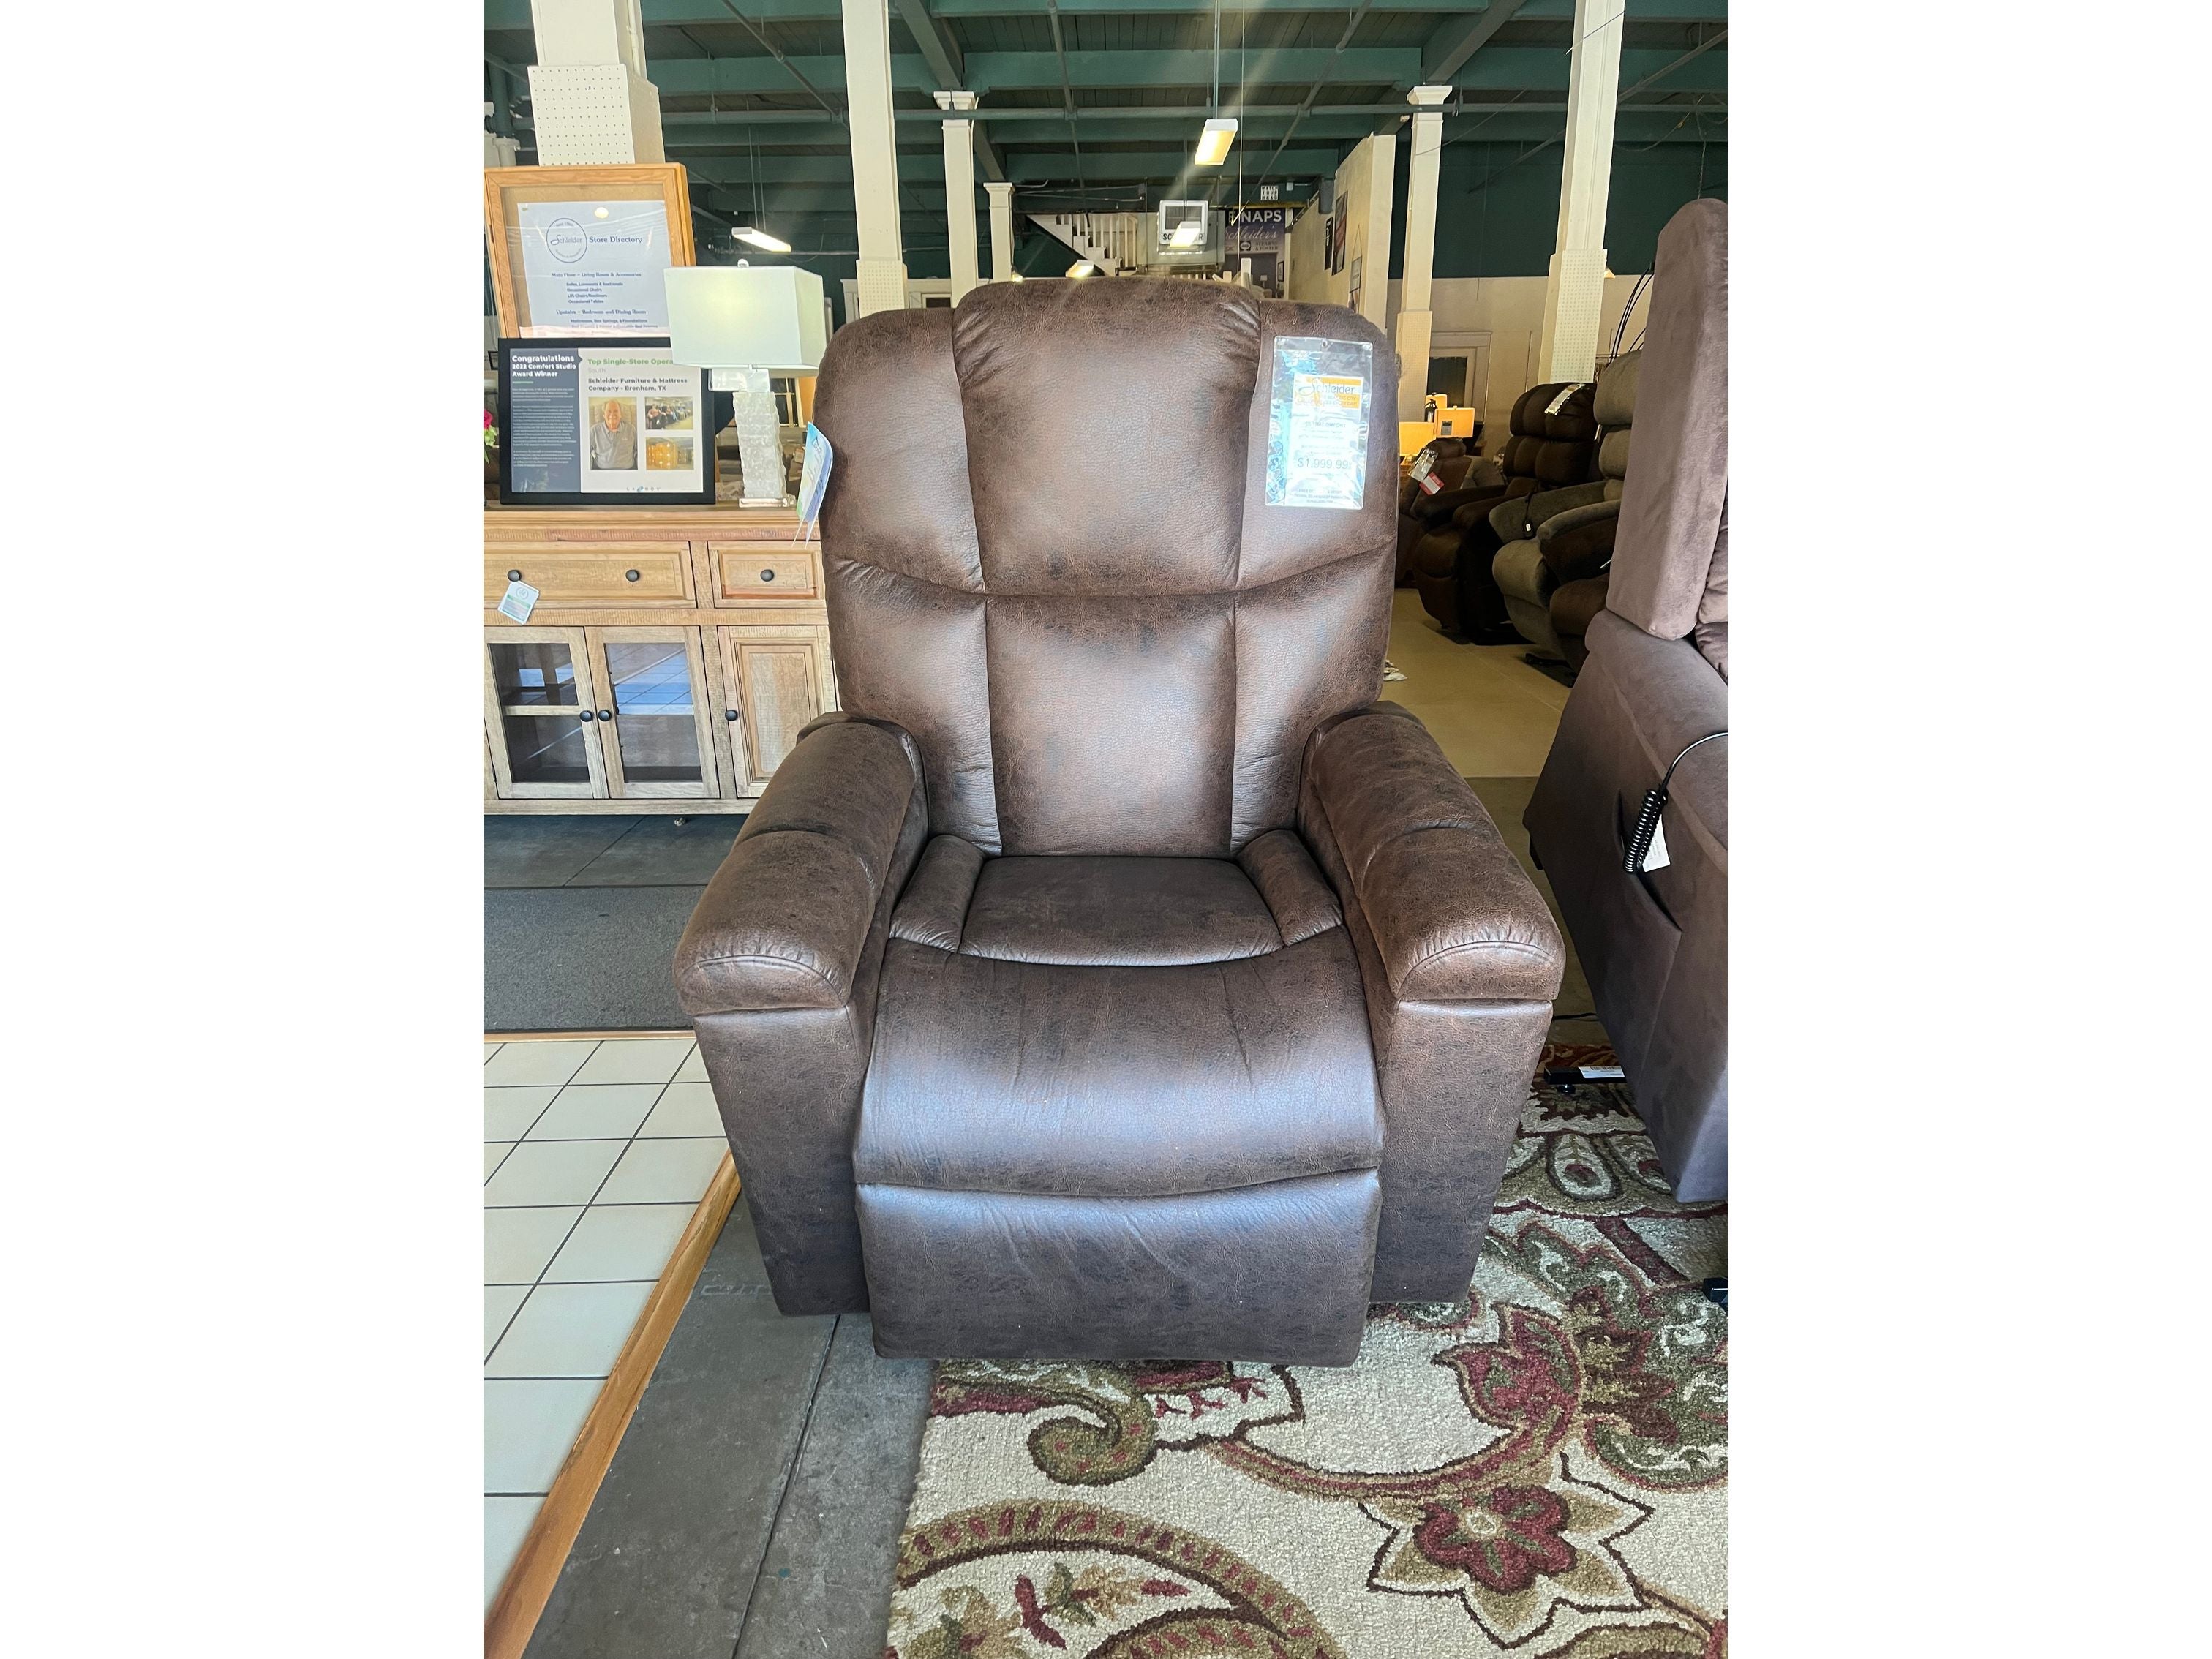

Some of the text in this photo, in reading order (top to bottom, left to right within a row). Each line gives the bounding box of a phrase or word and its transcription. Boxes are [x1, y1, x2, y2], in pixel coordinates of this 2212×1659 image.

[1241, 210, 1282, 223] NAPS
[550, 234, 582, 246] Schleider
[512, 355, 575, 363] Congratulations
[1298, 377, 1355, 396] Schleider
